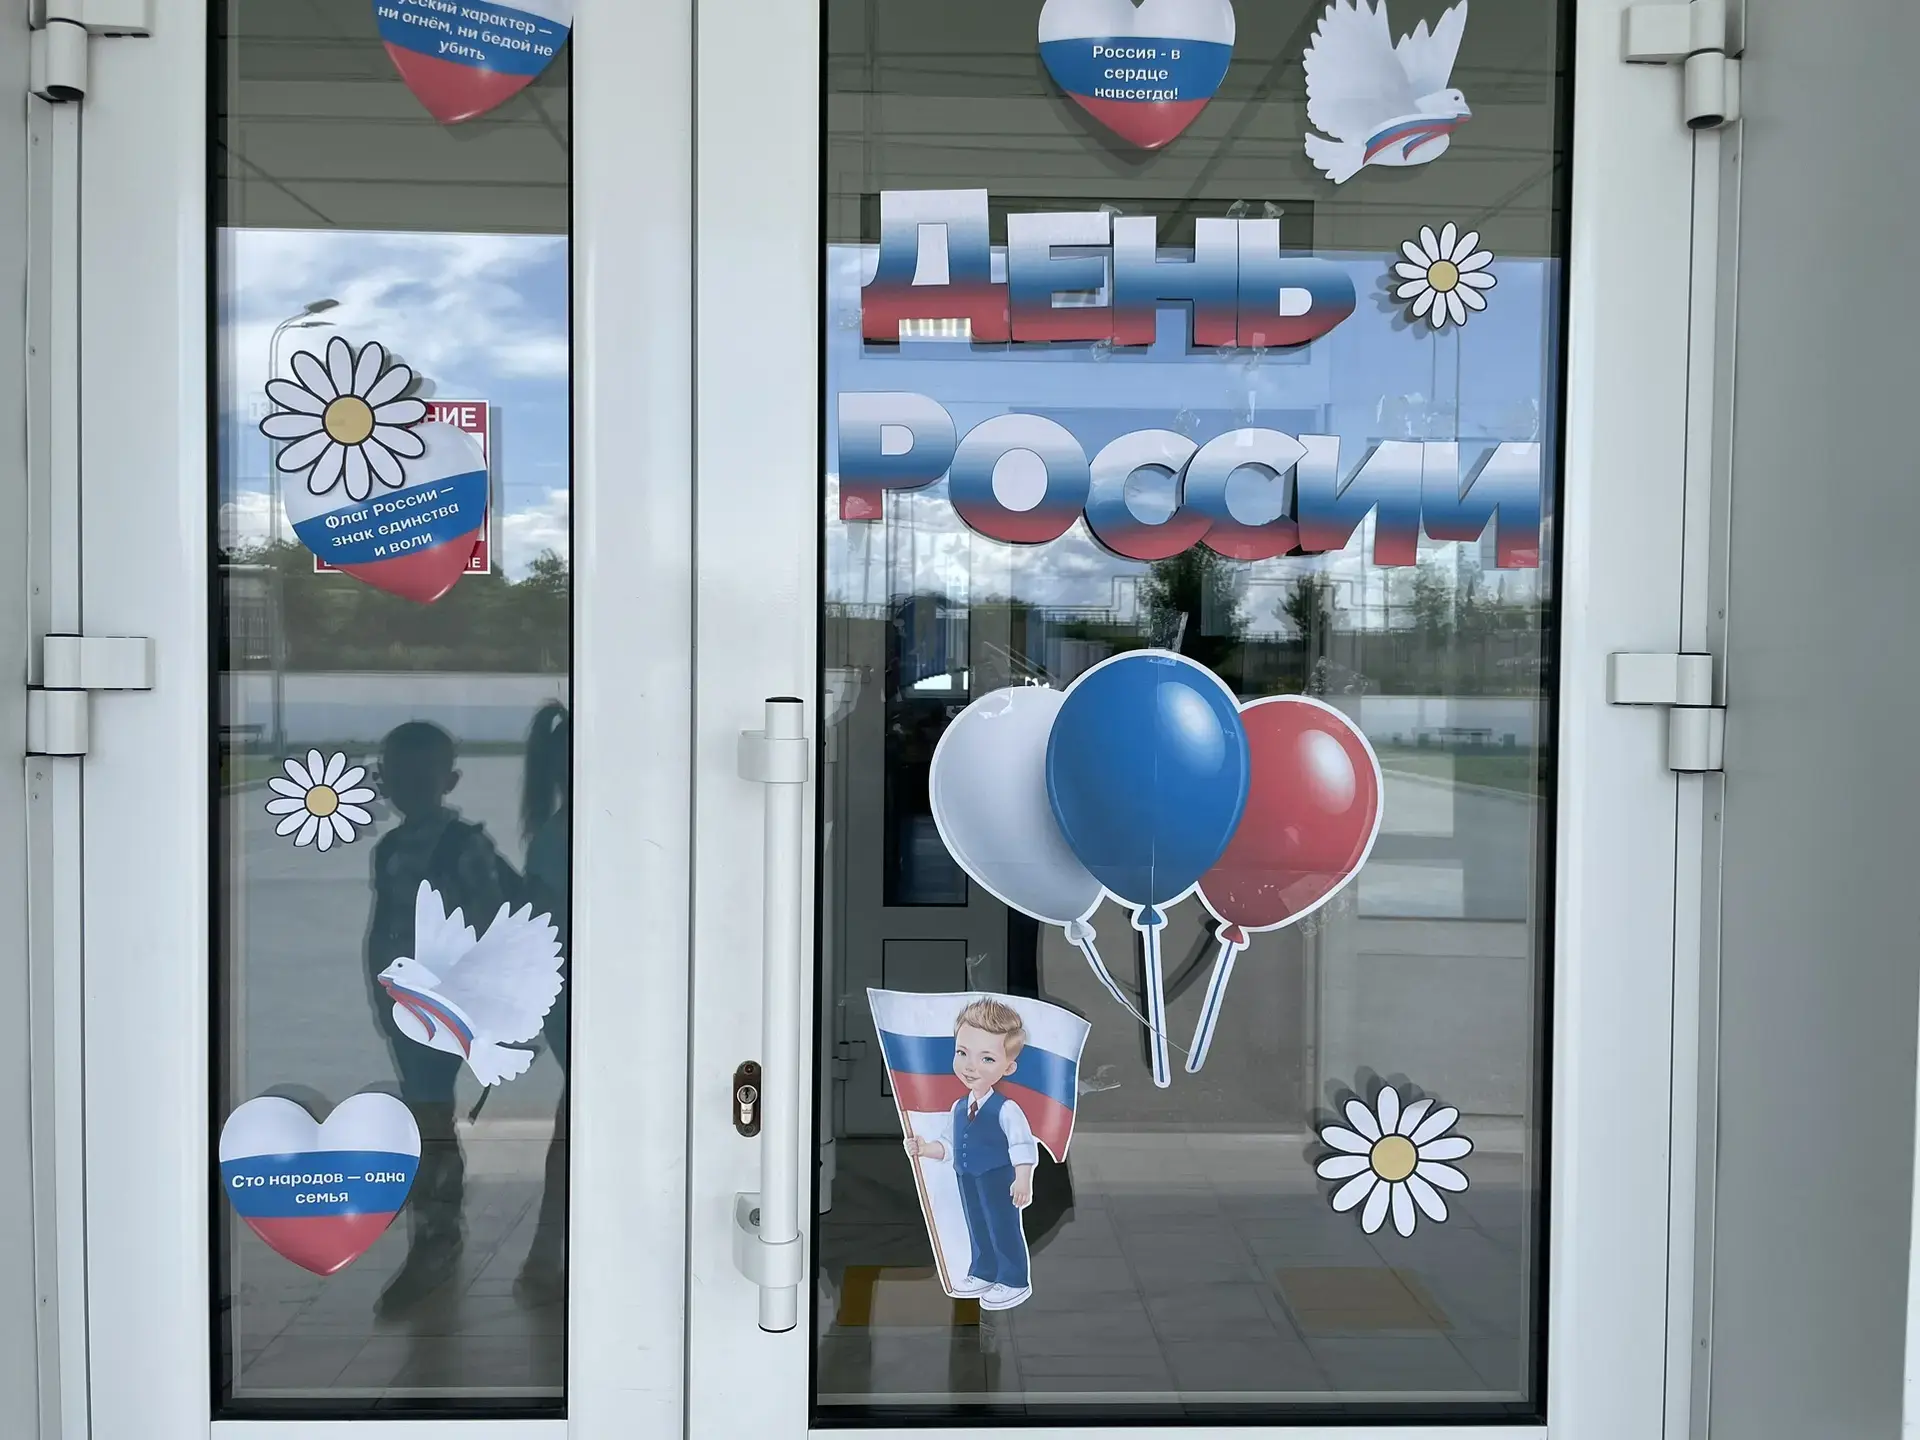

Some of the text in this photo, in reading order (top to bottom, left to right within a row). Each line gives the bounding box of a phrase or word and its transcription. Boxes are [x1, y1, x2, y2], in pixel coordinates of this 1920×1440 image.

[378, 6, 554, 57] ни огнём, ни бедой не
[461, 8, 536, 34] характер
[438, 40, 486, 61] убить
[1092, 45, 1156, 60] Россия
[1171, 49, 1181, 60] в
[1104, 68, 1169, 82] сердце
[1094, 87, 1179, 101] навсегда!
[861, 188, 1356, 347] ДЕНЬ
[838, 391, 1541, 569] РОССИИ
[324, 509, 370, 530] Флаг
[372, 489, 438, 518] России
[331, 502, 460, 548] знак единства
[374, 531, 434, 557] и воли
[231, 1174, 265, 1189] Сто
[269, 1172, 344, 1187] народов
[364, 1172, 406, 1184] одна
[295, 1192, 349, 1205] семья
